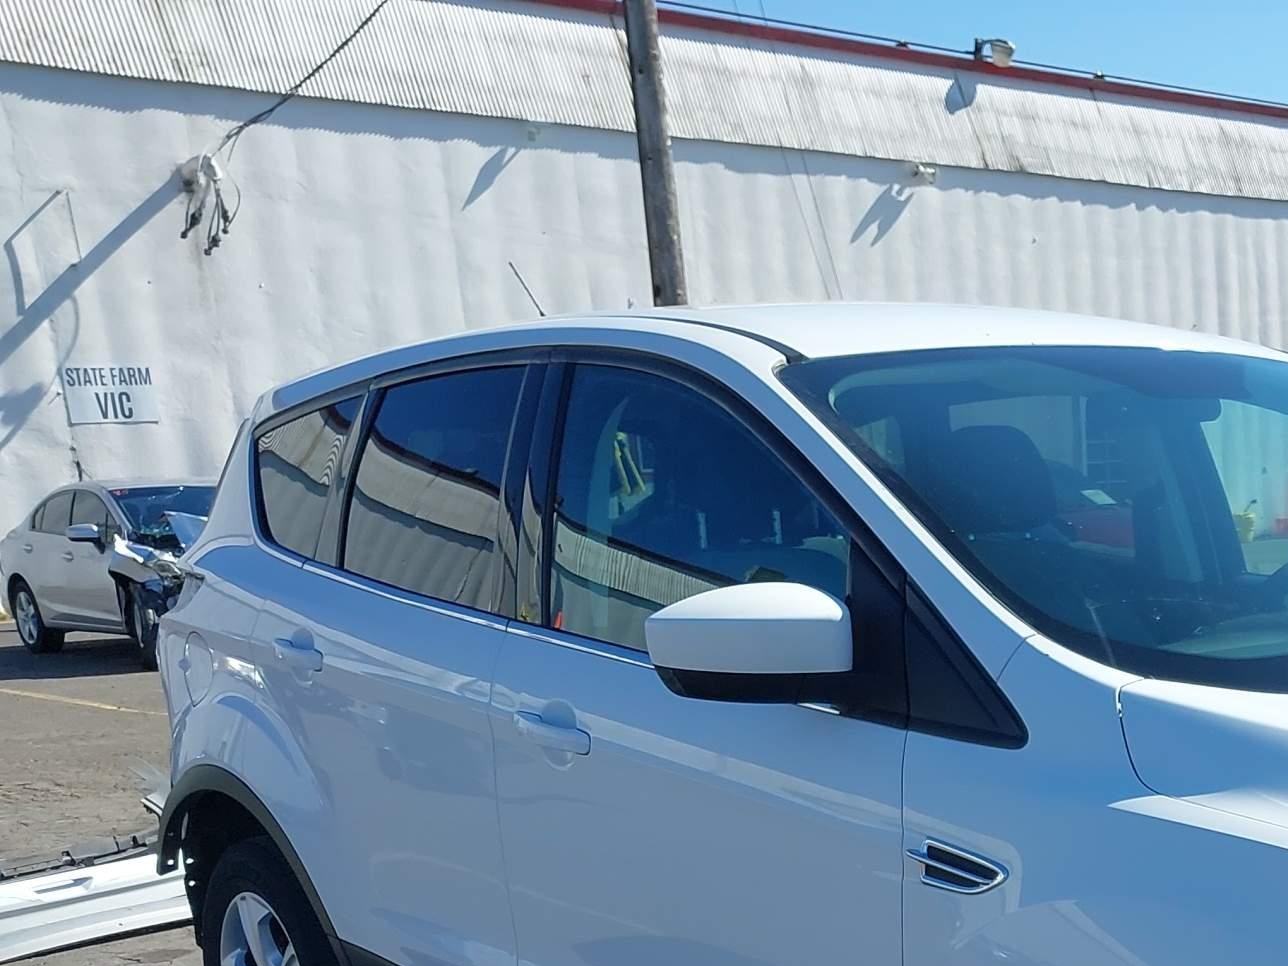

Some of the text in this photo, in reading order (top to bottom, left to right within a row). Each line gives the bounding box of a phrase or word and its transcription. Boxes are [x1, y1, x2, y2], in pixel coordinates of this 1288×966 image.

[65, 367, 152, 387] STATE FARM
[94, 391, 134, 420] VIC
